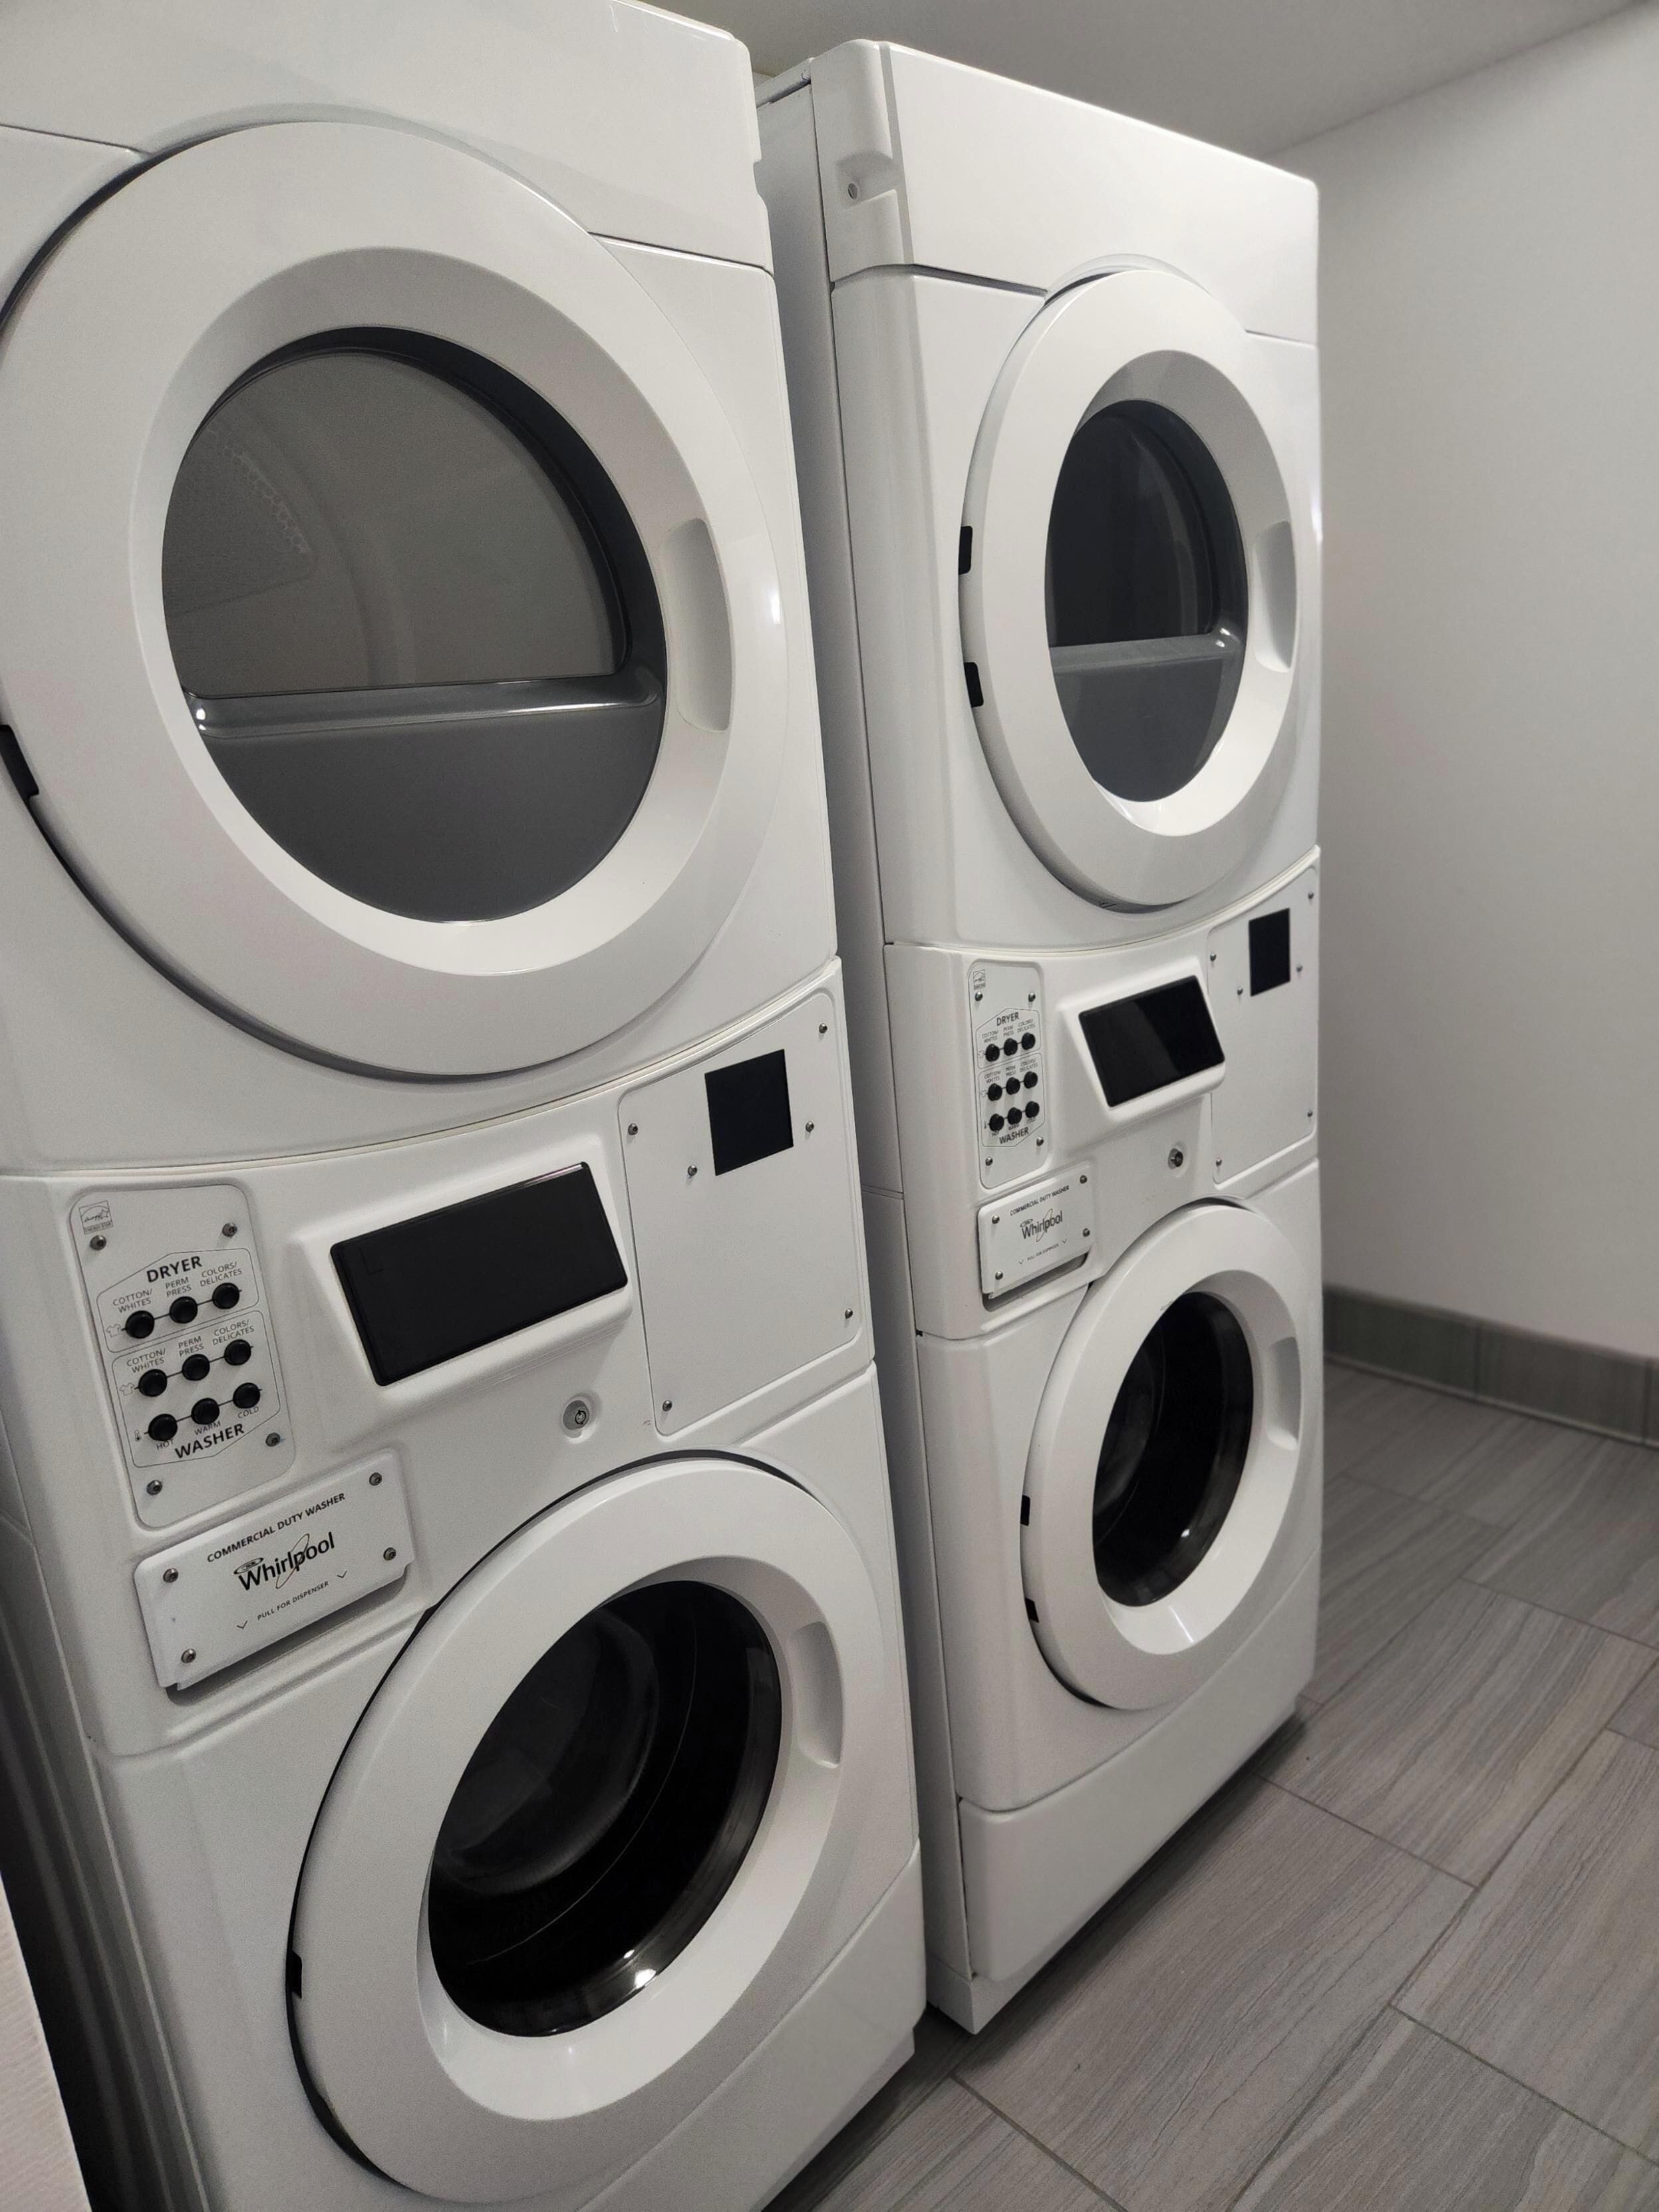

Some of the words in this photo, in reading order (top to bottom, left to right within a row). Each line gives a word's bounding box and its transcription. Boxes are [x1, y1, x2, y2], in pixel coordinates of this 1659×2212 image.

[996, 1012, 1019, 1026] DRYER
[999, 1127, 1029, 1144] WASHER
[1010, 1198, 1039, 1216] COMMERCIAL
[1040, 1193, 1051, 1202] DUTY
[1051, 1185, 1070, 1196] WASHER
[1022, 1210, 1063, 1239] Whirlpool
[146, 1255, 203, 1283] DRYER
[200, 1268, 243, 1287] DELICATES
[202, 1261, 237, 1278] COLORS/
[165, 1277, 189, 1289] PERM
[166, 1285, 192, 1298] PRESS
[112, 1288, 153, 1307] COTTON/
[118, 1298, 152, 1313] WHITES
[212, 1326, 255, 1346] DELICATES
[214, 1319, 249, 1337] COLORS/
[178, 1335, 202, 1348] PERM
[179, 1344, 204, 1356] PRESS
[126, 1348, 166, 1367] COTTON/
[132, 1357, 164, 1373] WHITES
[237, 1406, 259, 1418] COLD
[194, 1420, 221, 1435] WARM
[156, 1439, 174, 1450] HOT
[174, 1423, 245, 1458] WASHER
[207, 1525, 276, 1563] COMMERCIAL
[277, 1511, 303, 1531] DUTY
[305, 1492, 346, 1517] WASHER
[238, 1531, 335, 1591] Whirlpool
[257, 1607, 276, 1621] PULL
[276, 1599, 291, 1612] FOR
[291, 1580, 330, 1604] DISPENSER
